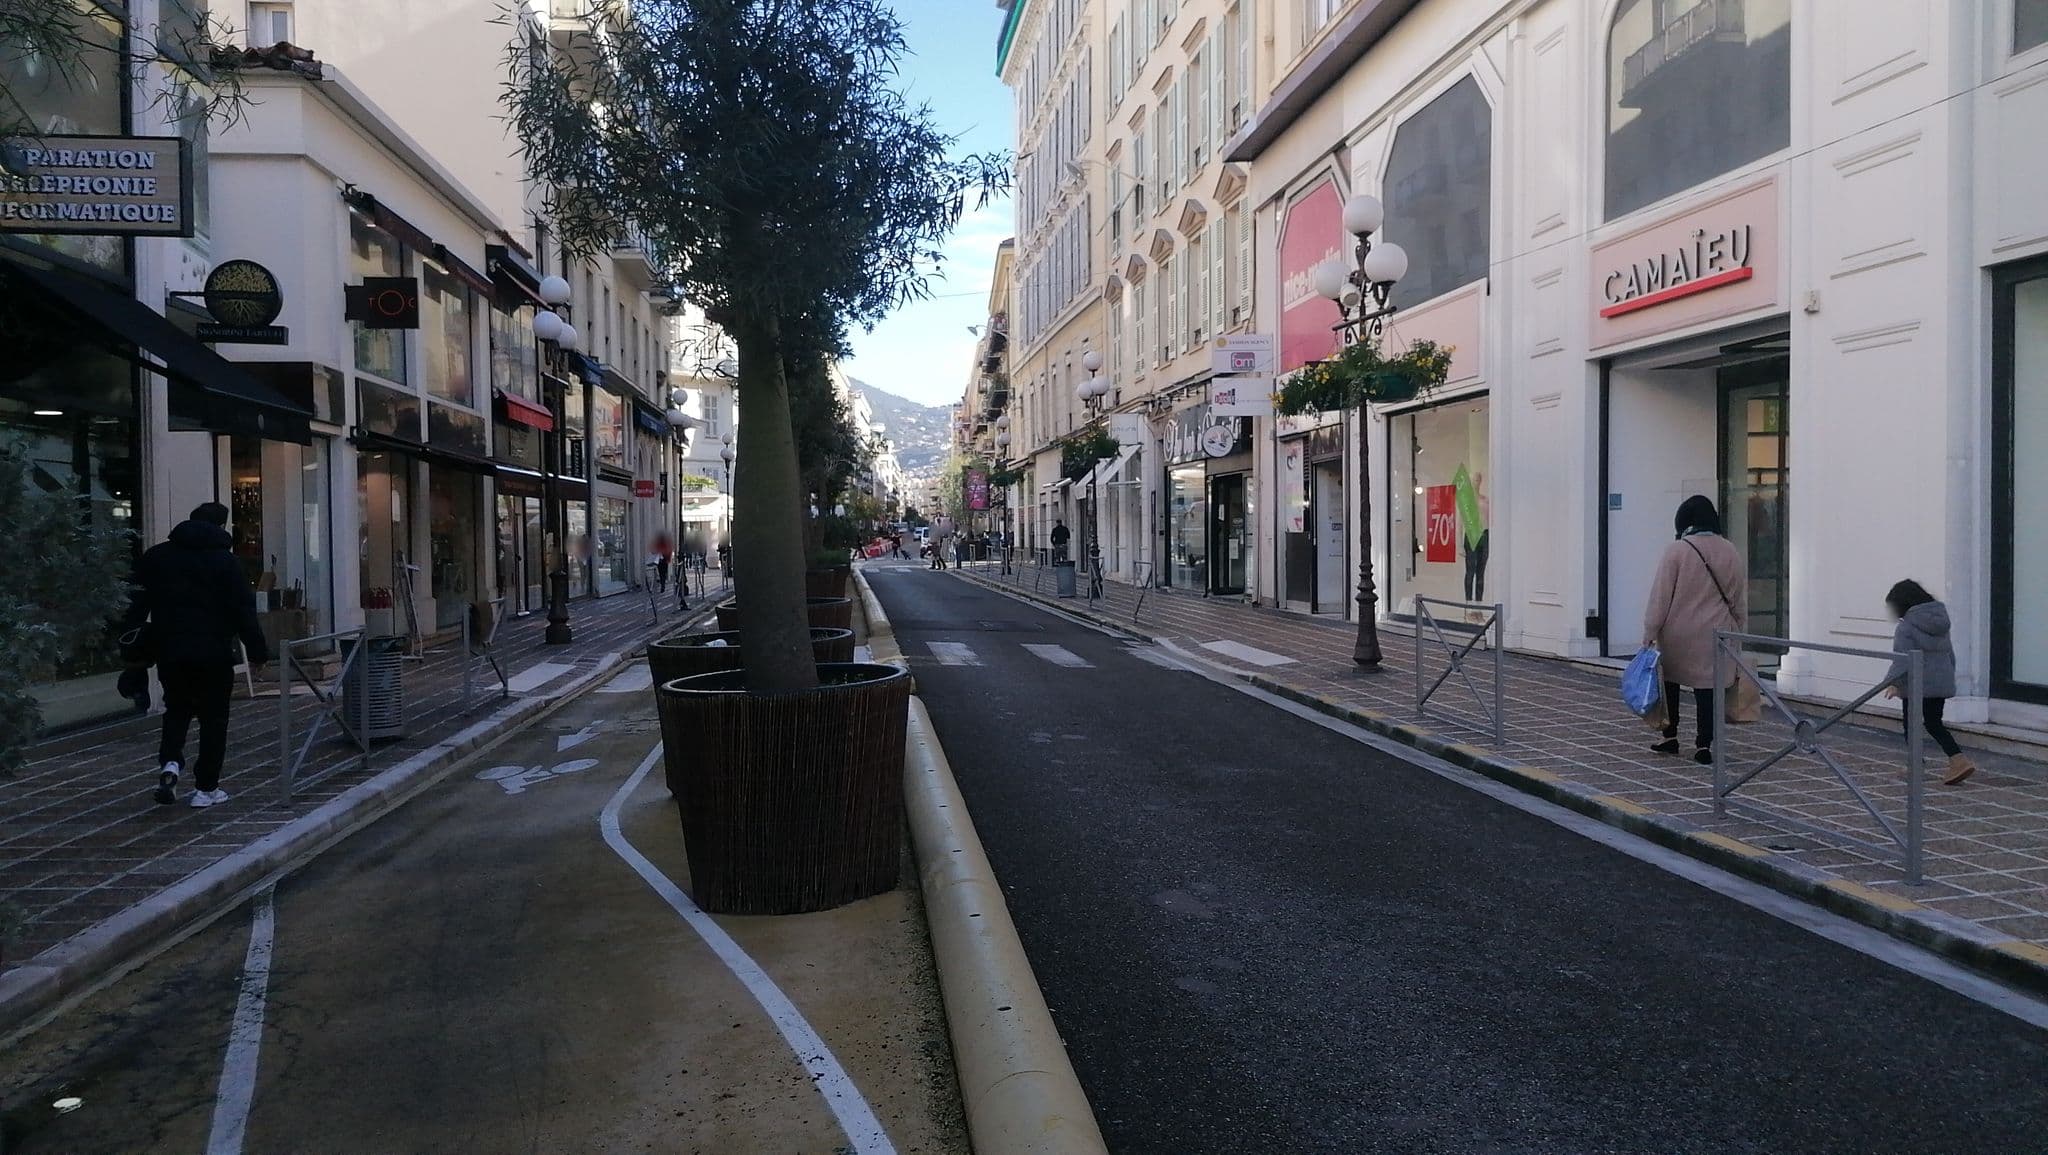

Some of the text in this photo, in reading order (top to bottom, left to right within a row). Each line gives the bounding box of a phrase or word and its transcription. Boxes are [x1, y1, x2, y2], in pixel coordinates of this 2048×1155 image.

[22, 149, 157, 170] PARATION
[0, 201, 176, 223] FORMATIQUE
[1283, 246, 1342, 305] nice-mtin
[1604, 224, 1751, 303] CAMAÏEU
